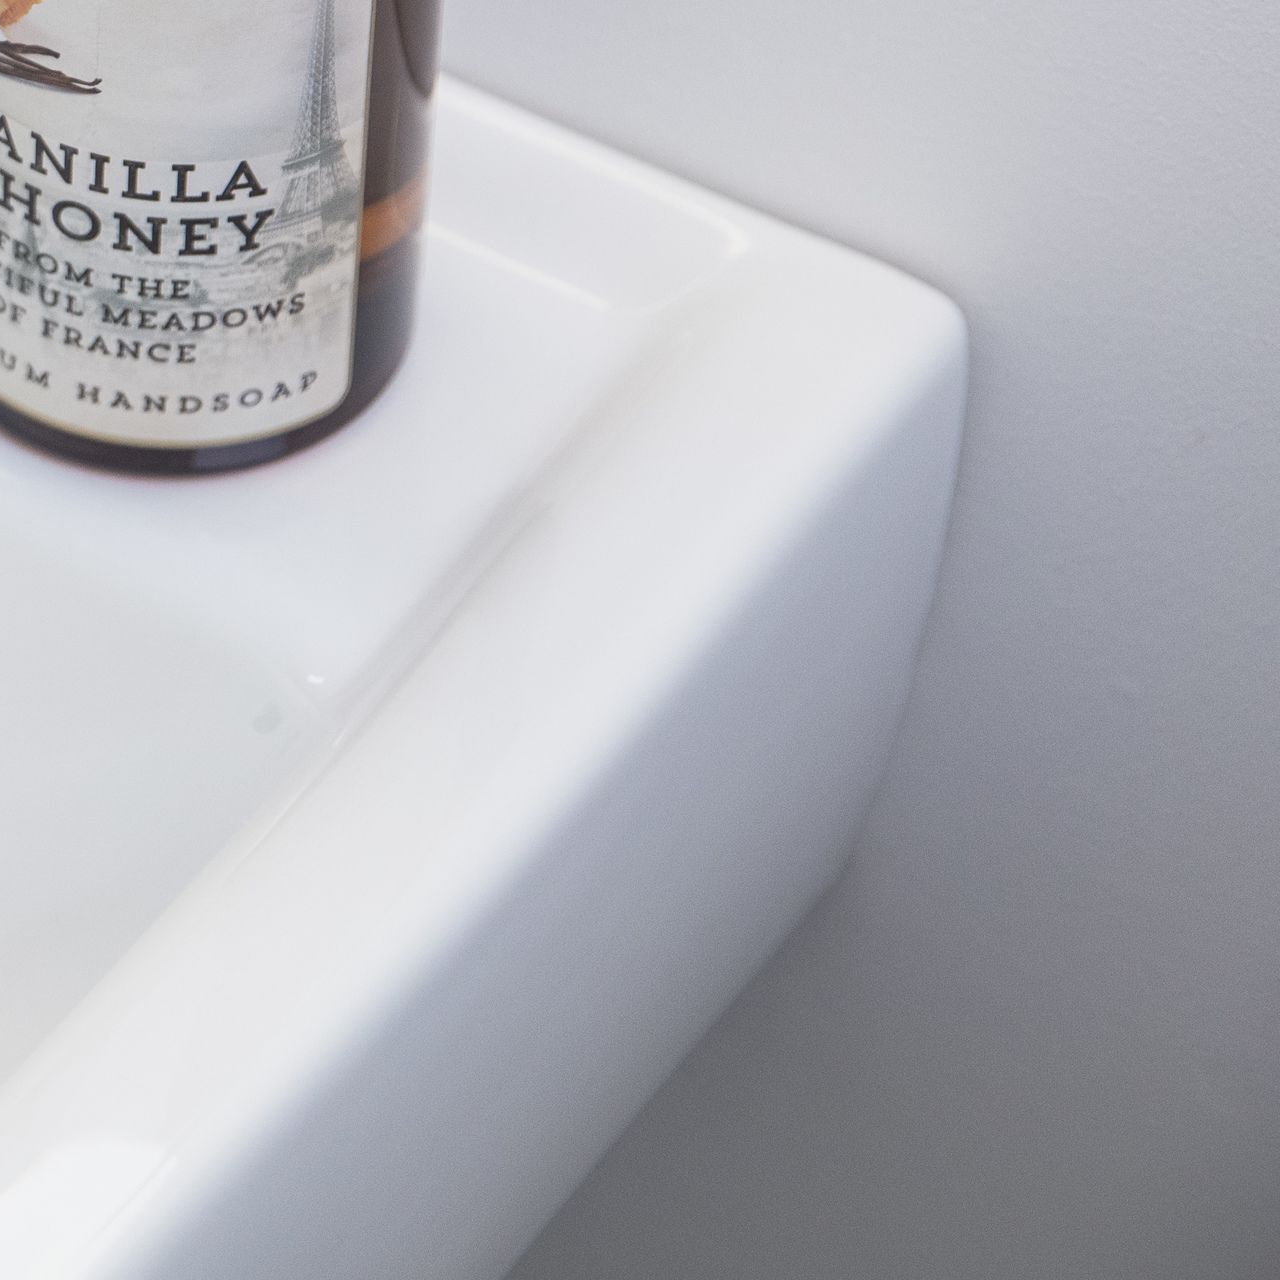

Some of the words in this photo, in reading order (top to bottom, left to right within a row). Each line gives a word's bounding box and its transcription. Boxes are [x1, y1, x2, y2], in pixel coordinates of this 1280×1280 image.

[111, 273, 191, 301] THE
[101, 291, 307, 333] MEADOWS
[42, 317, 198, 365] FRANCE
[76, 370, 319, 415] HANDSOAP
